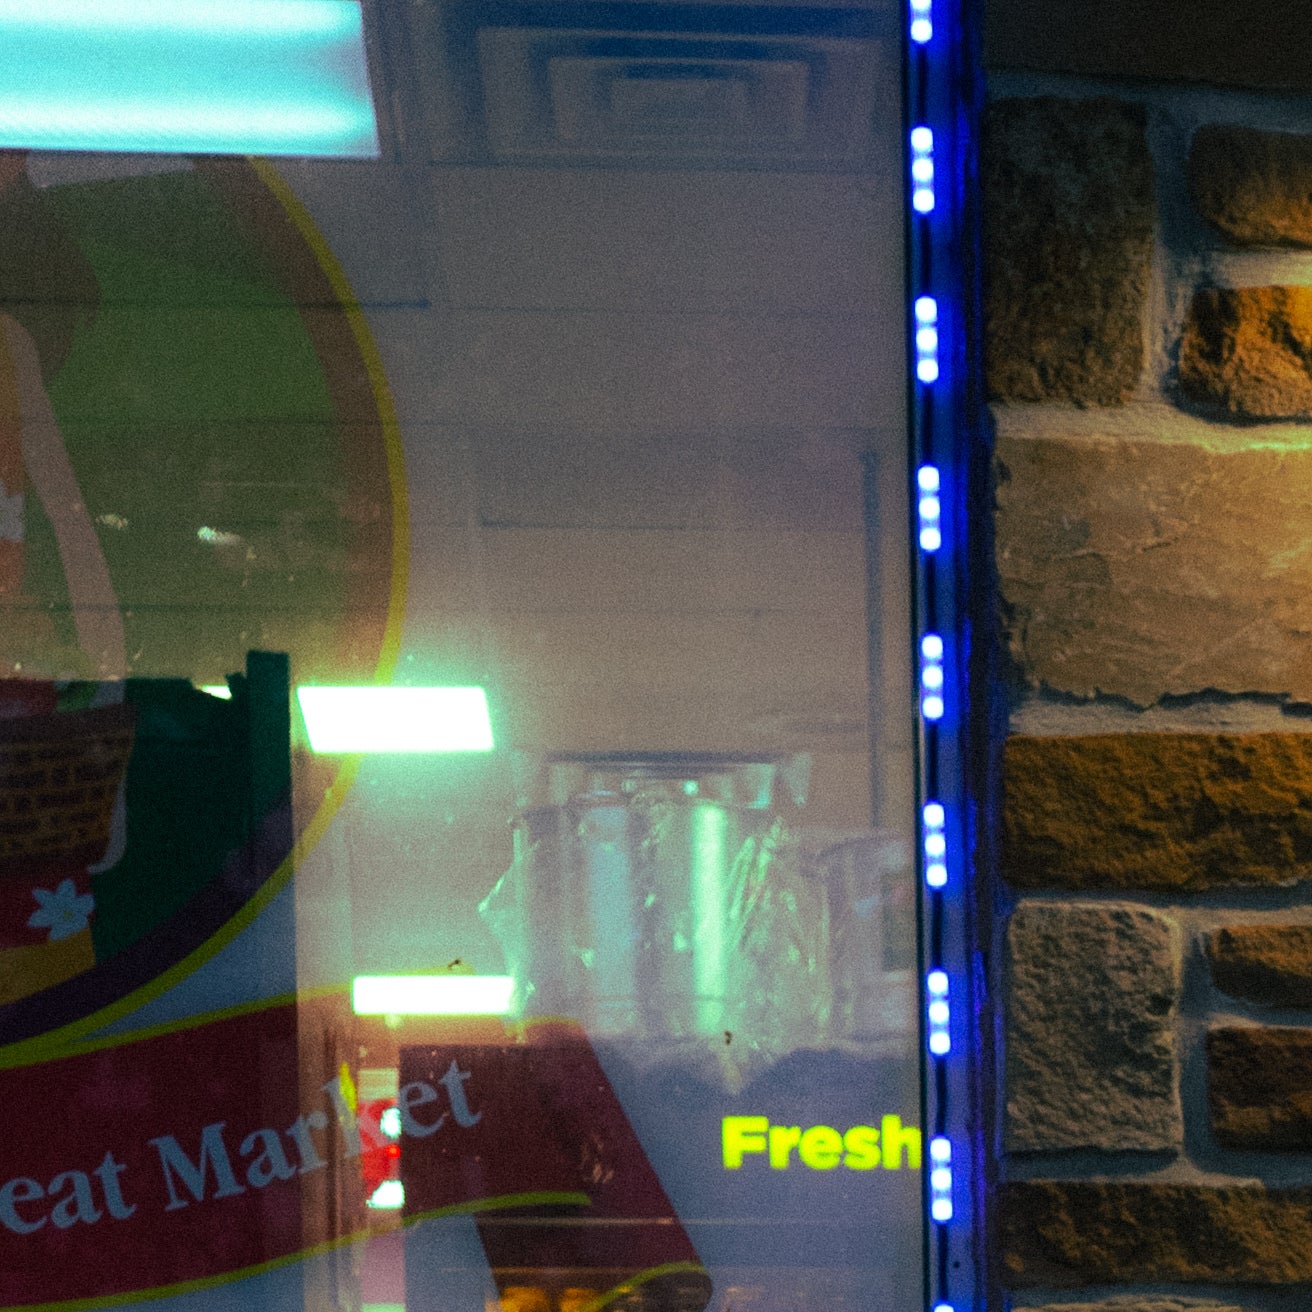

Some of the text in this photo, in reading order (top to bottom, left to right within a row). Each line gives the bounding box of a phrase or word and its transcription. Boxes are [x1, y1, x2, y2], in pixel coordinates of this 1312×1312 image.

[0, 1059, 483, 1235] eat Market
[721, 1114, 922, 1170] Fresh
